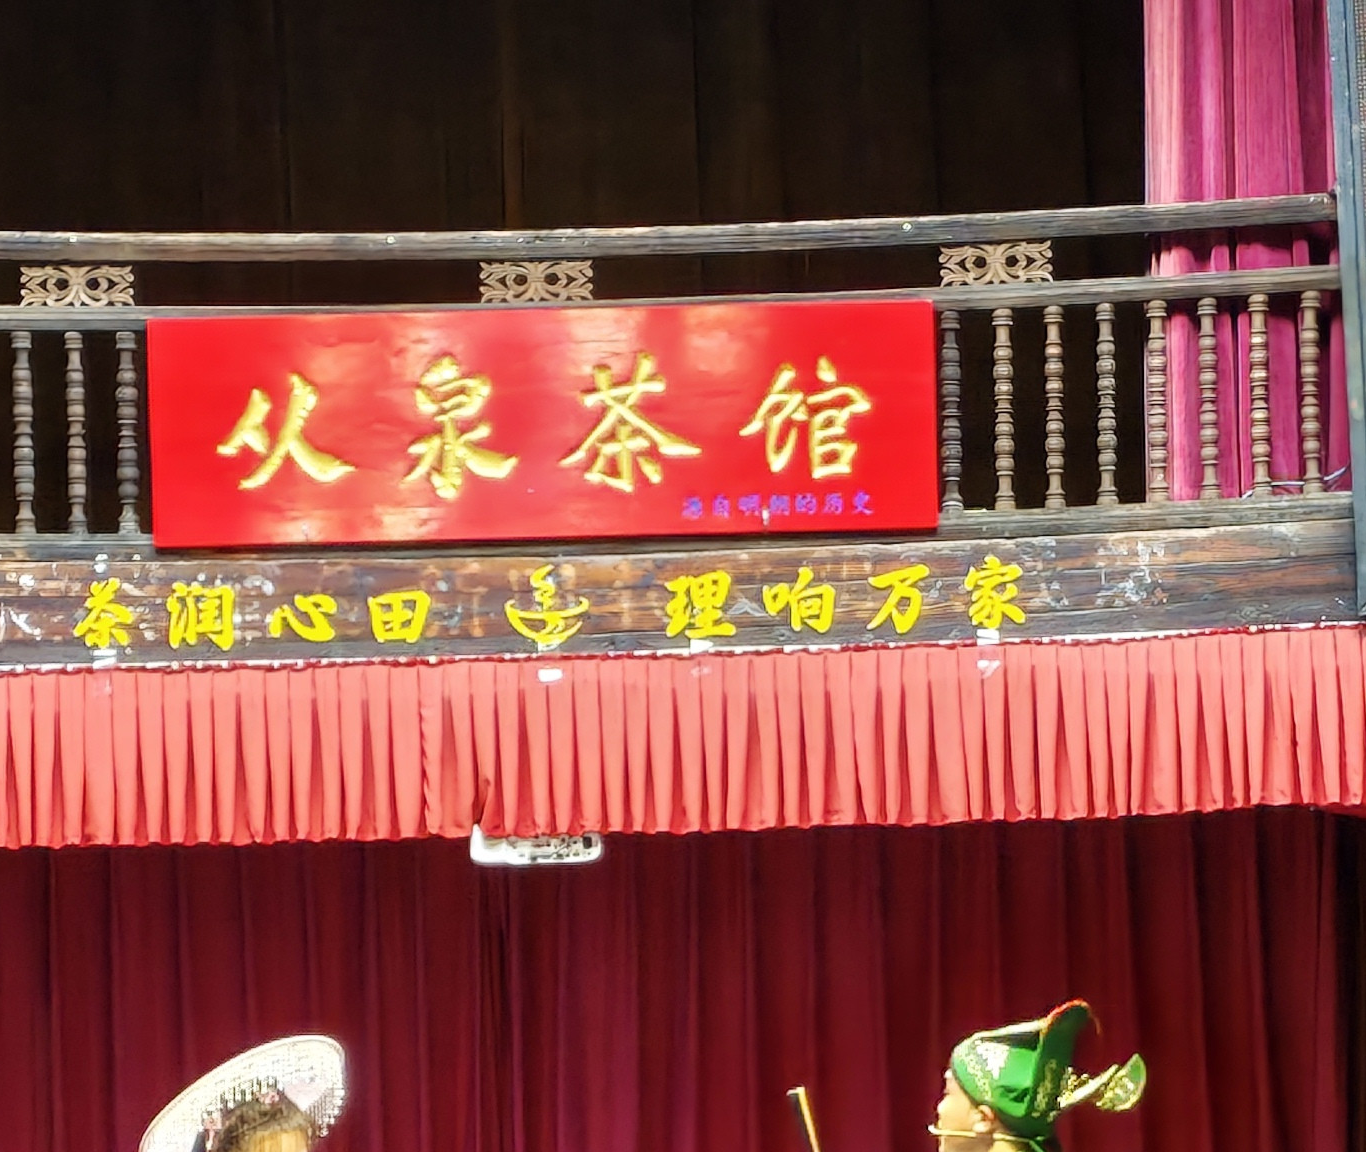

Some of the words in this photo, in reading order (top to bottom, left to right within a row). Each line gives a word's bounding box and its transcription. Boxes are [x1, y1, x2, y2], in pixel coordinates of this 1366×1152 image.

[217, 352, 873, 500] 从泉茶馆
[73, 578, 433, 650] 茶润心田
[664, 556, 1029, 640] 理响万家
